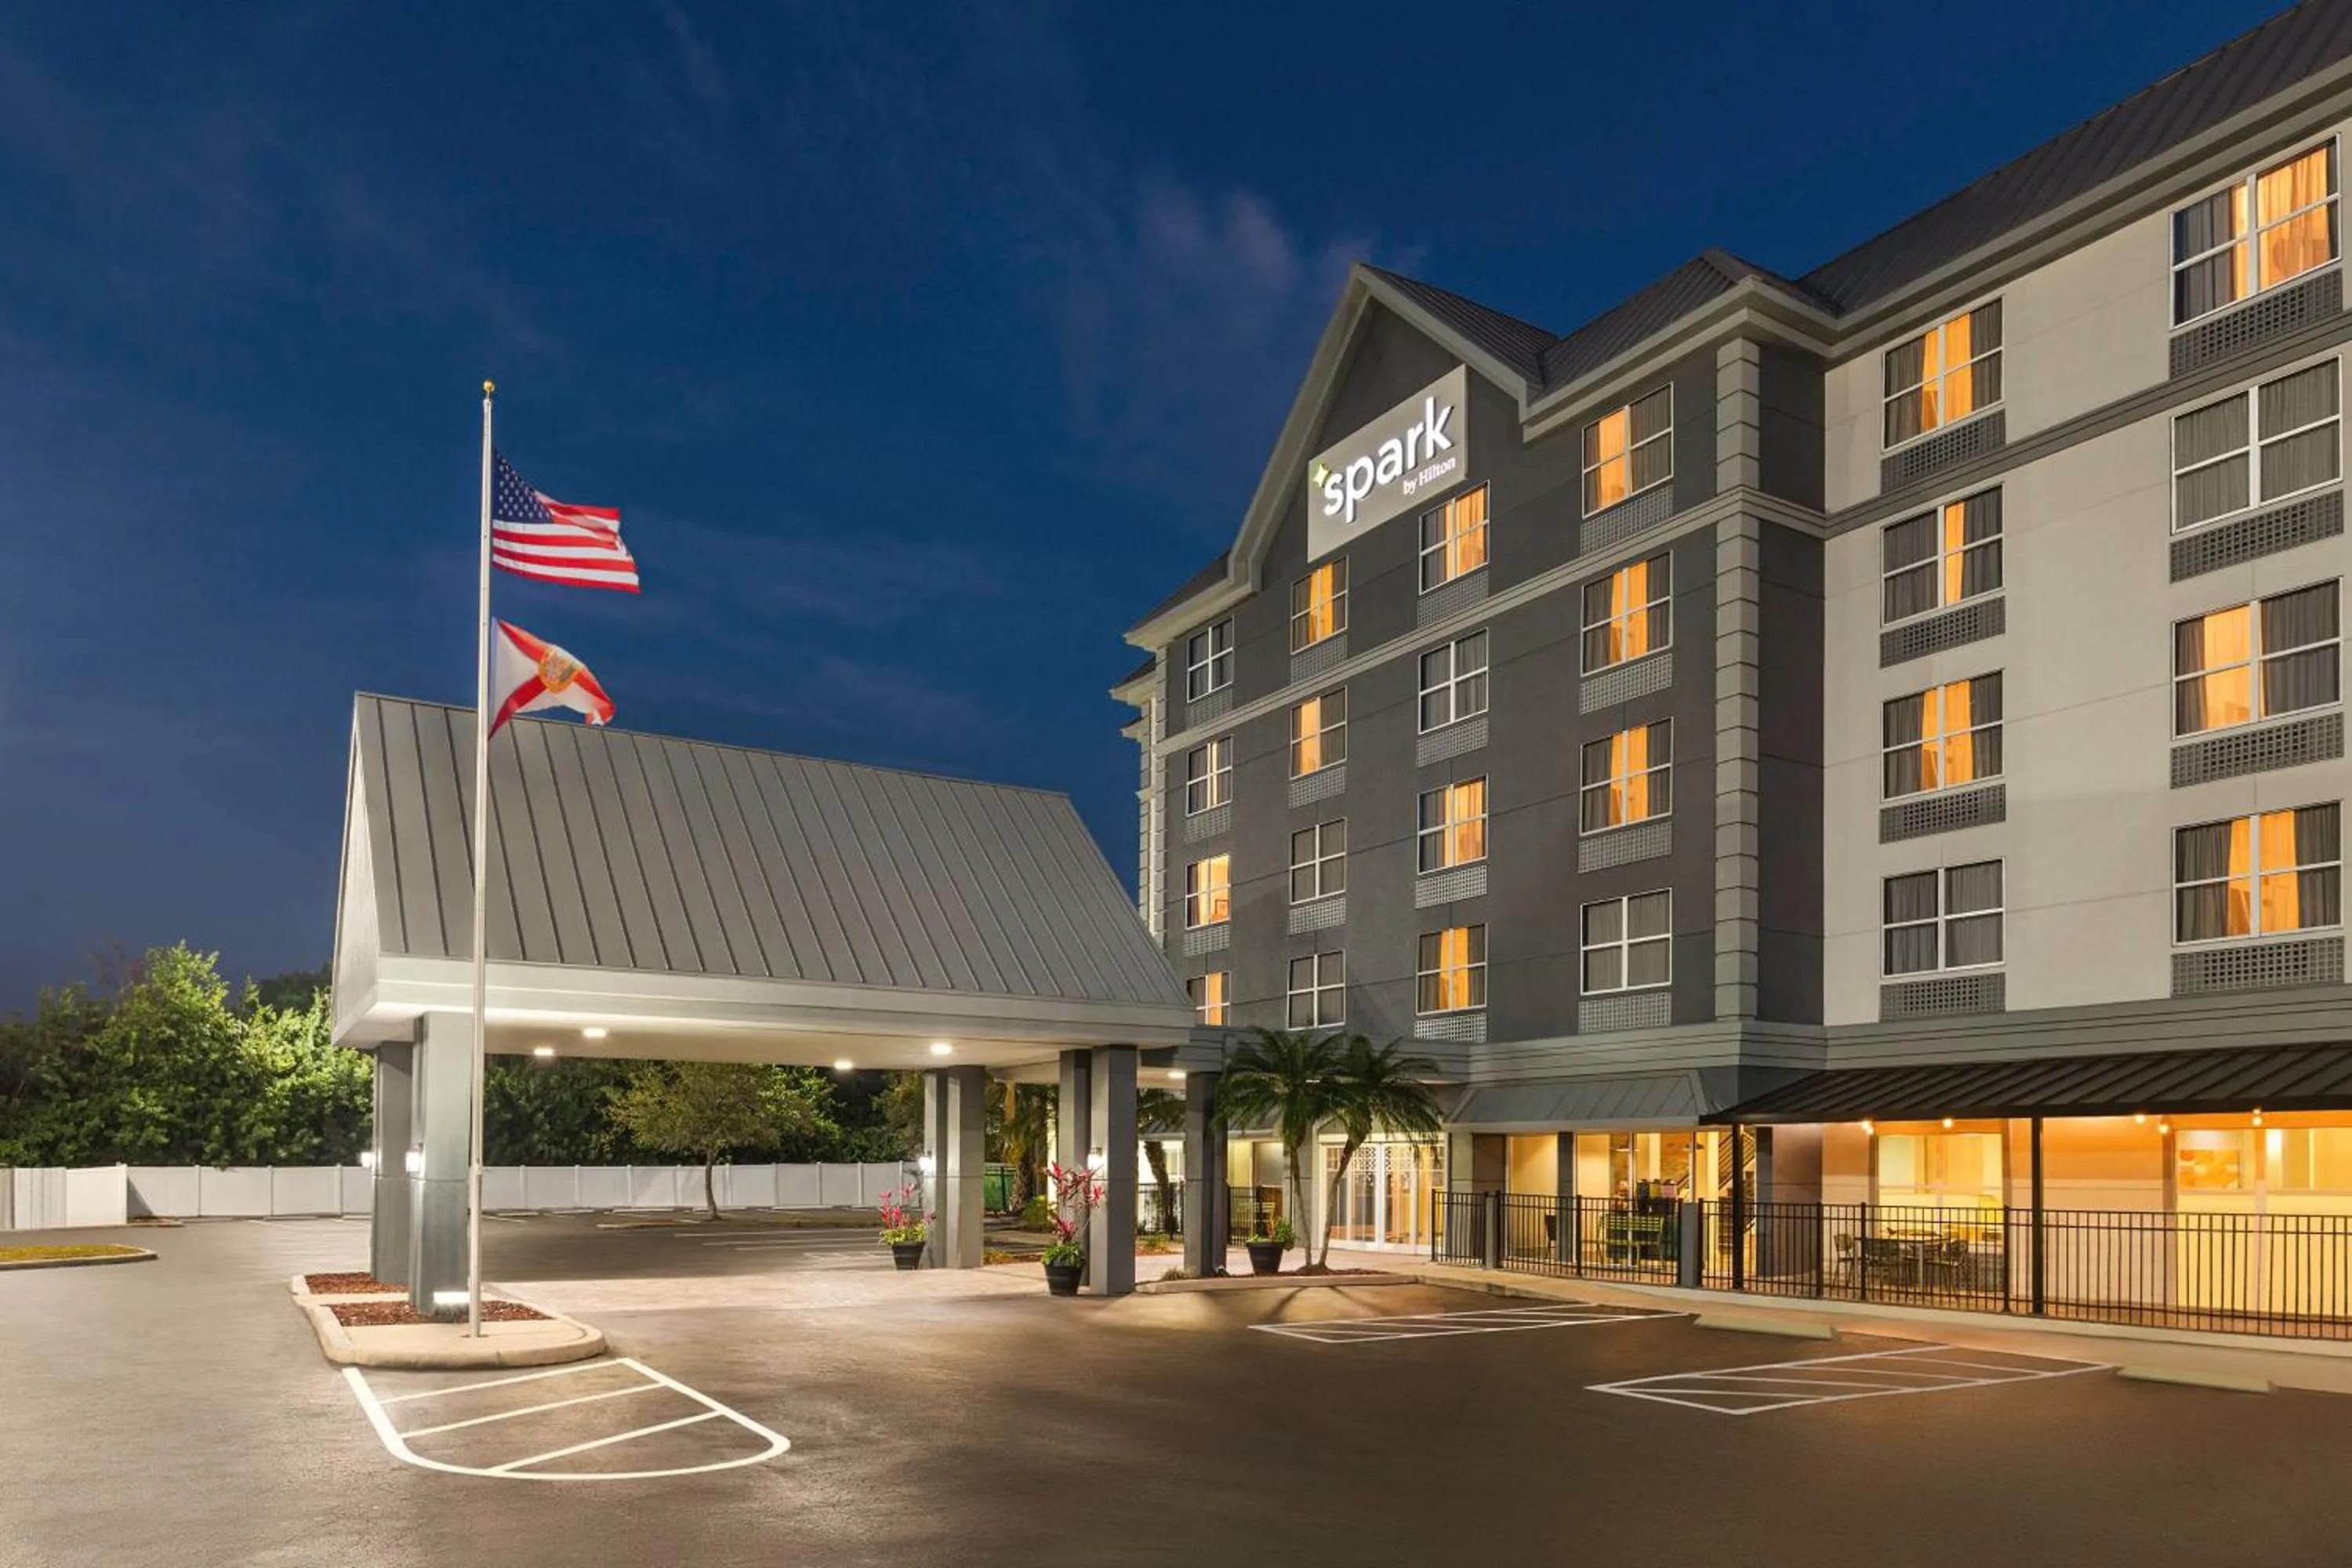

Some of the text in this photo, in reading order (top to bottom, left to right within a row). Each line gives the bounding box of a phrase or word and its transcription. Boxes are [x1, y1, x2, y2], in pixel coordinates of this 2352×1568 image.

[1323, 395, 1453, 524] spark
[1403, 457, 1456, 495] by Hilton
